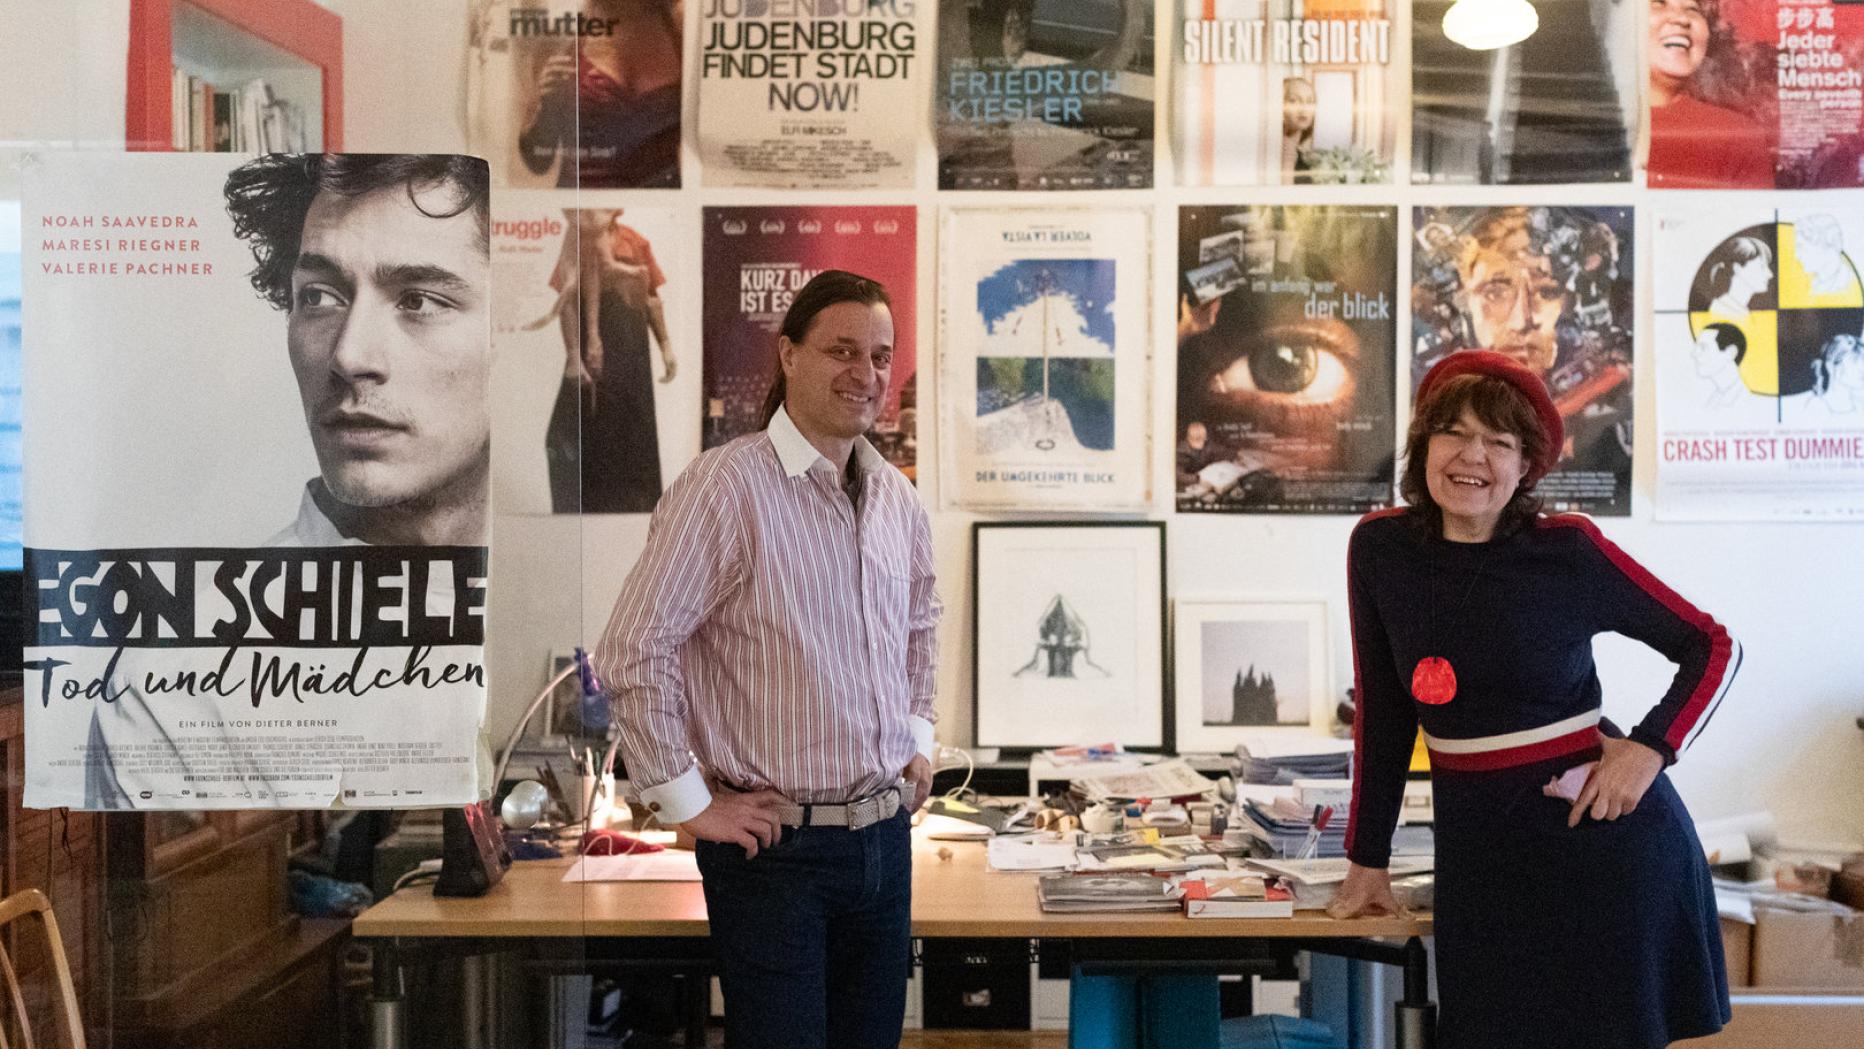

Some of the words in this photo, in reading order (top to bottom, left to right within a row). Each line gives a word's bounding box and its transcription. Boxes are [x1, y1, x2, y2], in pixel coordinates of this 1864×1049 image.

[510, 10, 620, 36] mutter
[704, 21, 916, 50] JUDENBURG
[1184, 19, 1266, 65] SILENT
[1273, 19, 1391, 65] RESIDENT
[1776, 30, 1836, 50] Jeder
[703, 53, 809, 79] FINDET
[816, 52, 916, 79] STADT
[1777, 50, 1844, 69] siebte
[950, 69, 1121, 96] FRIEDRICH
[1778, 68, 1862, 88] Mensch
[769, 82, 859, 112] NOW!
[948, 97, 1083, 123] KIESLER
[42, 216, 93, 228] NOAH
[102, 216, 199, 228] SAAVEDRA
[42, 239, 110, 251] MARESI
[118, 239, 201, 251] RIEGNER
[42, 262, 118, 275] VALERIE
[126, 262, 213, 275] PACHNER
[741, 269, 787, 291] KURZ
[741, 291, 767, 312] IST
[771, 291, 795, 312] ES
[1304, 291, 1339, 320] der
[1343, 291, 1390, 320] blick
[1663, 438, 1728, 461] CRASH
[1733, 438, 1779, 460] TEST
[975, 470, 997, 483] DER
[1001, 471, 1078, 483] UMGEKEHRTE
[1083, 472, 1116, 483] BLICK
[24, 552, 195, 642] EGON
[211, 552, 486, 642] SCHIELE
[23, 642, 131, 708] Tod
[144, 642, 246, 697] und
[250, 644, 485, 708] Mädchen
[178, 720, 197, 728] EIN
[200, 720, 225, 728] FILM
[229, 720, 251, 728] VON
[255, 720, 292, 728] DIETER
[296, 719, 338, 728] BERNER
